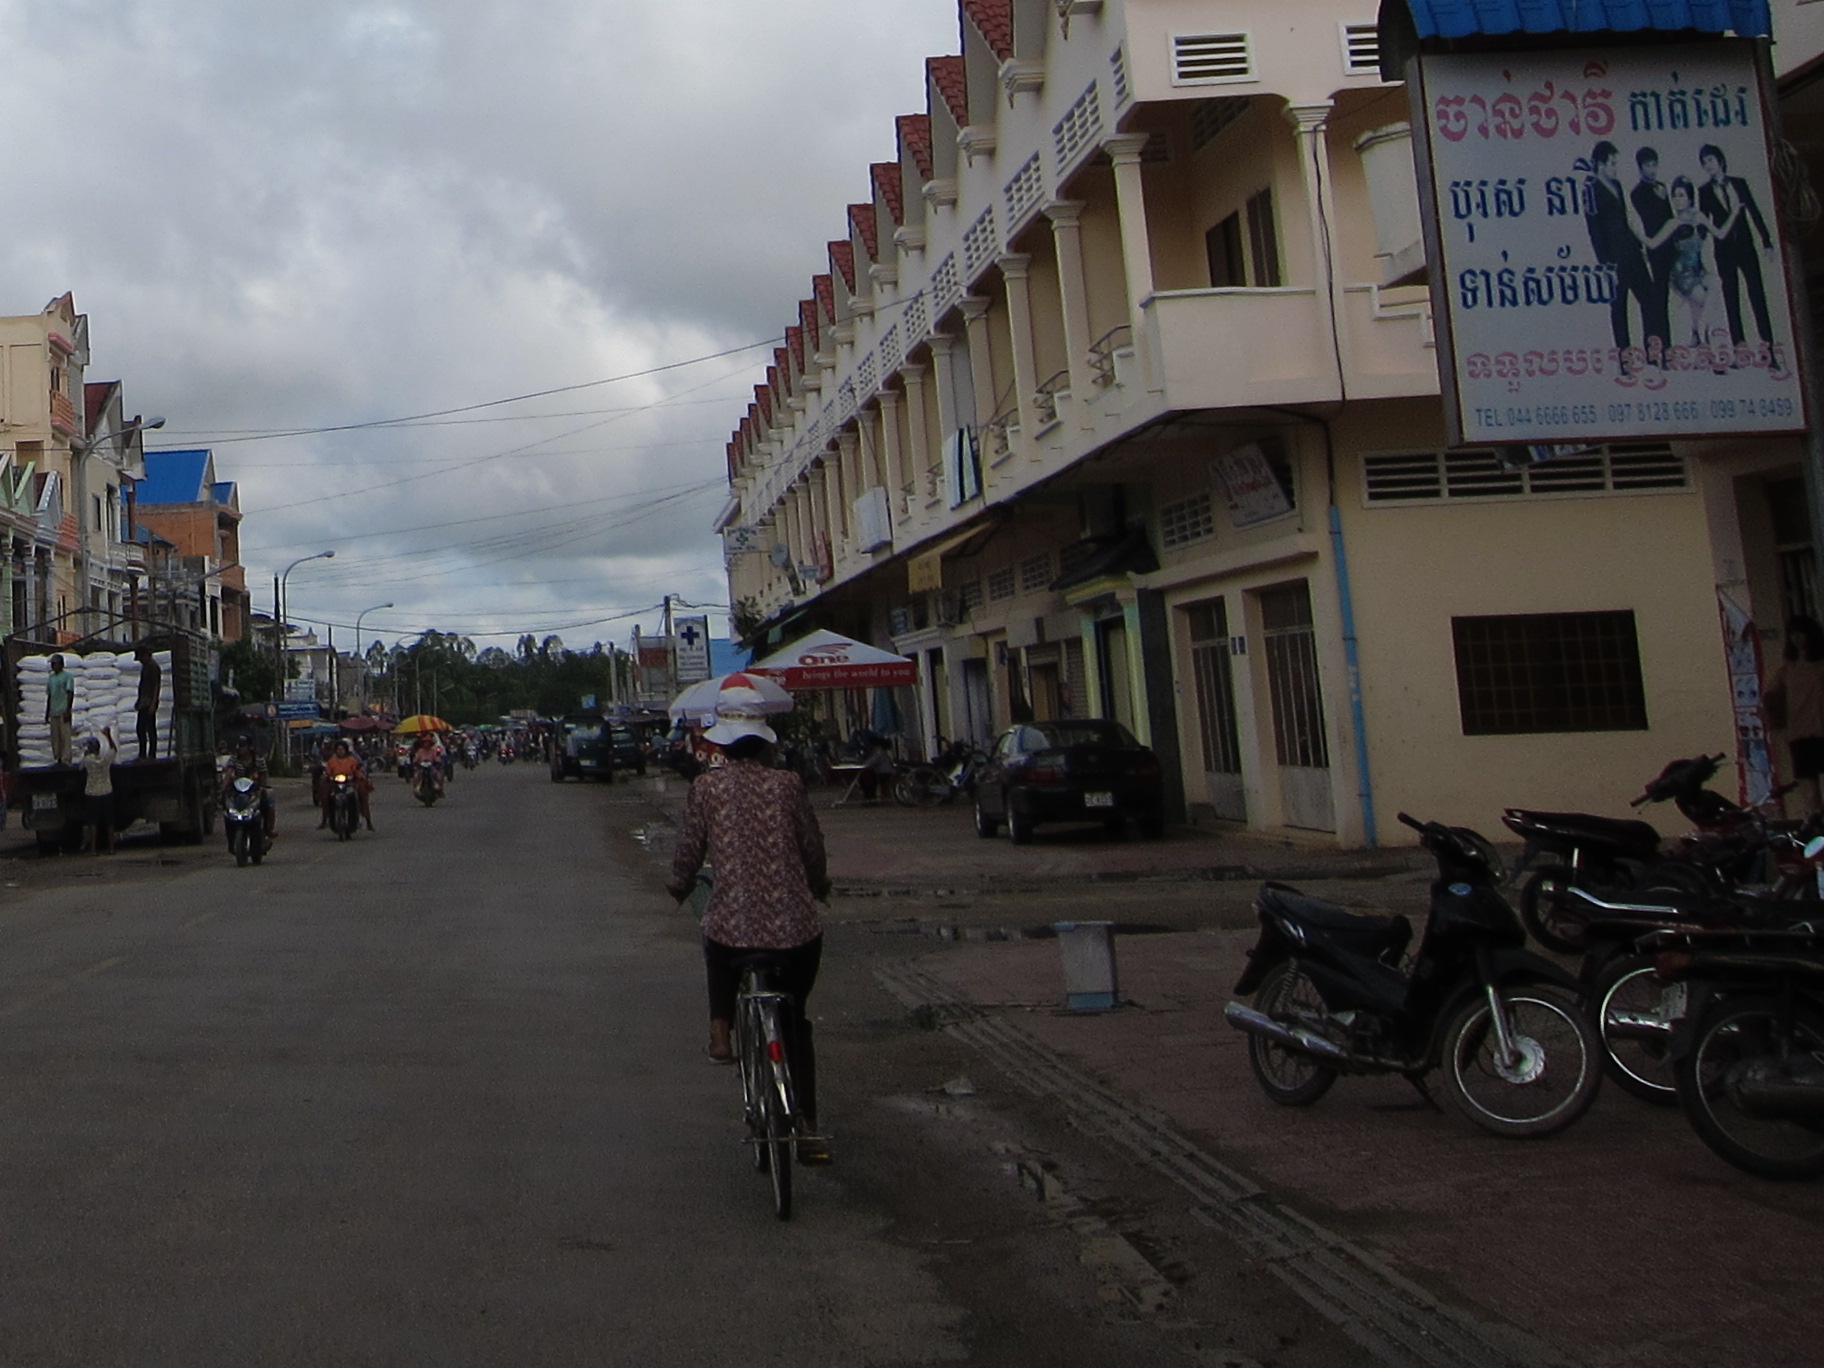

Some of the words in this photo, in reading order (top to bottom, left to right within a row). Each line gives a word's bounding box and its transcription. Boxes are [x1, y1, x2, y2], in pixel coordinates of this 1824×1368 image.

[1507, 407, 1533, 426] 044
[798, 654, 850, 666] One
[802, 669, 832, 681] brings
[834, 668, 848, 678] the
[850, 667, 879, 678] world
[893, 668, 911, 679] you
